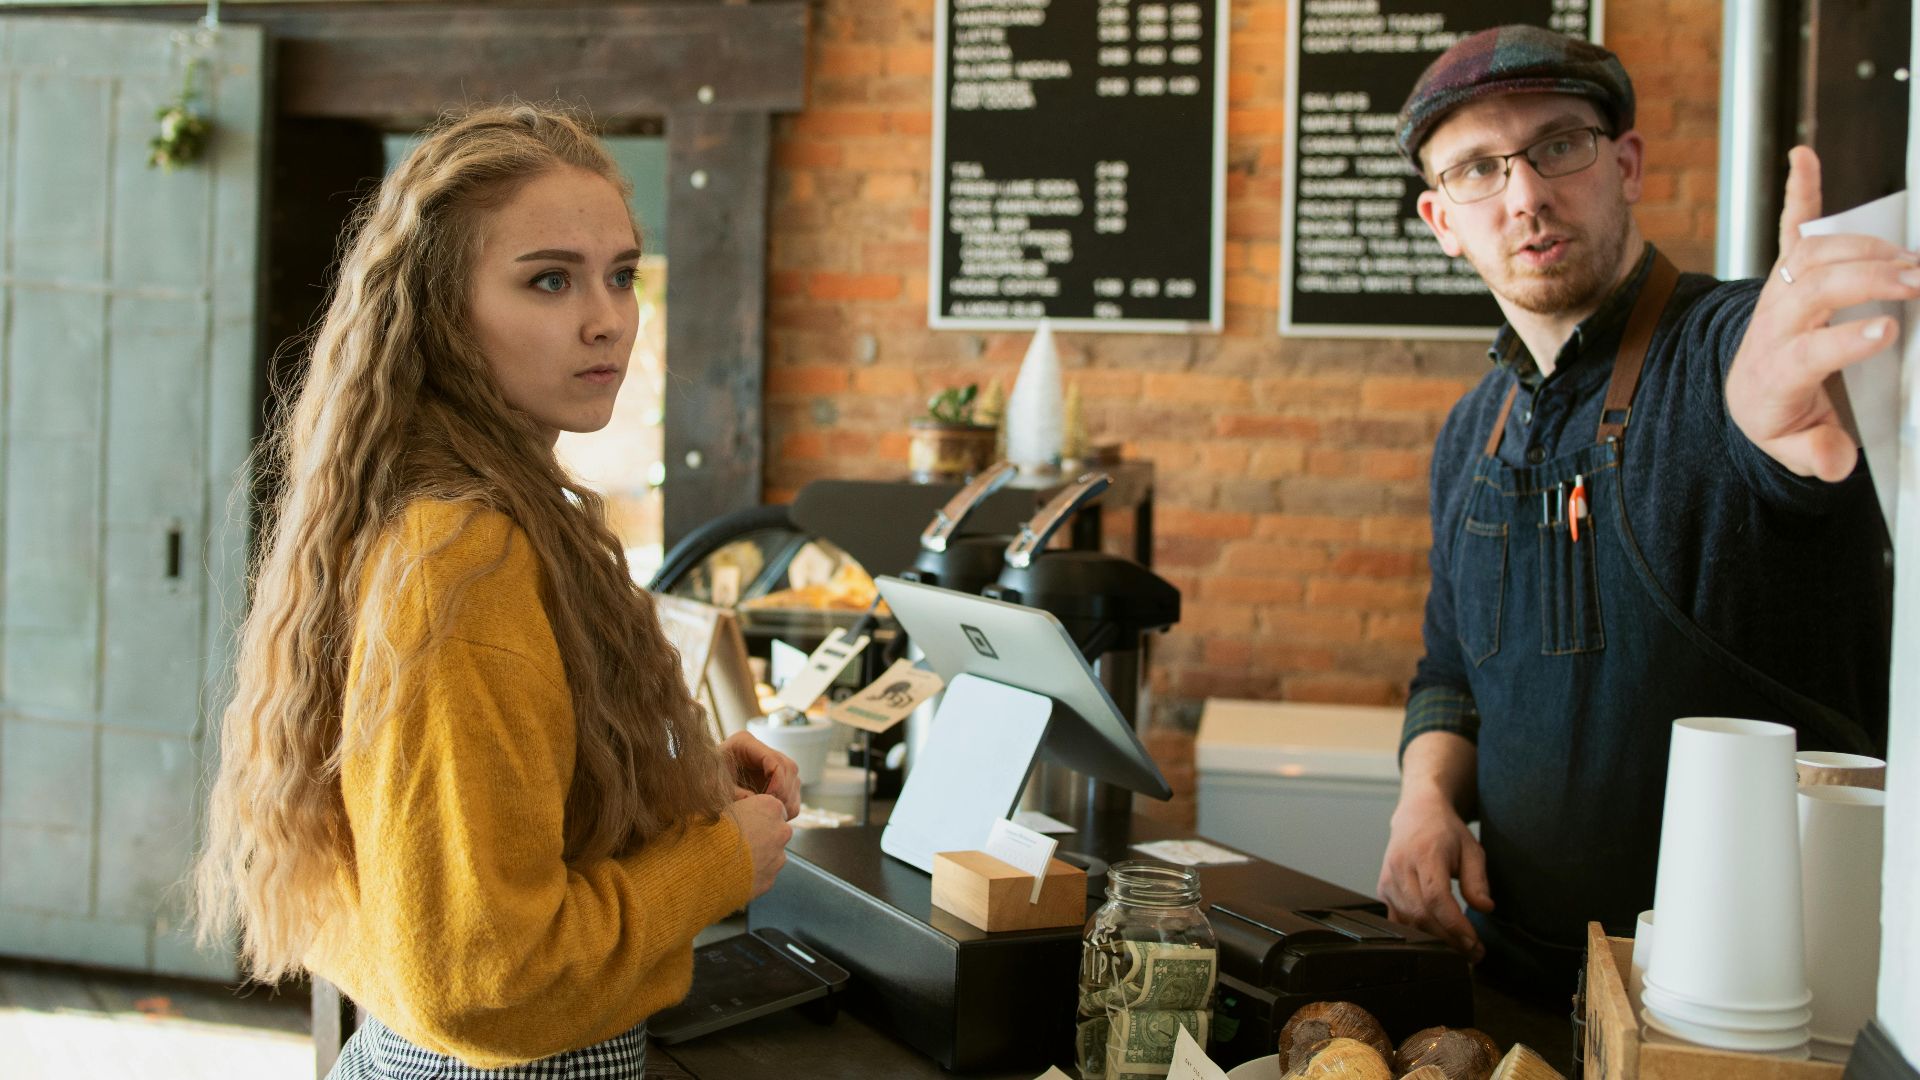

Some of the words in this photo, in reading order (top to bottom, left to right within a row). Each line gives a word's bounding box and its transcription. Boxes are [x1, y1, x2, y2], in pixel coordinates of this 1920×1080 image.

[1304, 17, 1385, 34] AVOCADO
[1387, 15, 1444, 33] TOAST
[1350, 34, 1421, 50] CHEESE
[1016, 61, 1071, 77] MOCHA
[1303, 94, 1369, 110] SALADS
[1302, 115, 1352, 131] MAPLE
[951, 163, 983, 179] TEA
[1302, 158, 1347, 174] SOUP
[951, 181, 1000, 197] FRESH
[1036, 181, 1078, 196] SODA
[1301, 180, 1404, 196] SANDWICHES
[994, 199, 1081, 214] AMERICANO
[1299, 201, 1356, 218] ROAST
[1357, 201, 1400, 218] BEEF
[1299, 220, 1353, 236] BACON
[1022, 231, 1070, 247] PRESS
[951, 278, 1000, 294] HOUSE
[1001, 278, 1060, 295] COFFEE
[1298, 275, 1363, 291] GRILLED
[1362, 275, 1415, 291] WHITE
